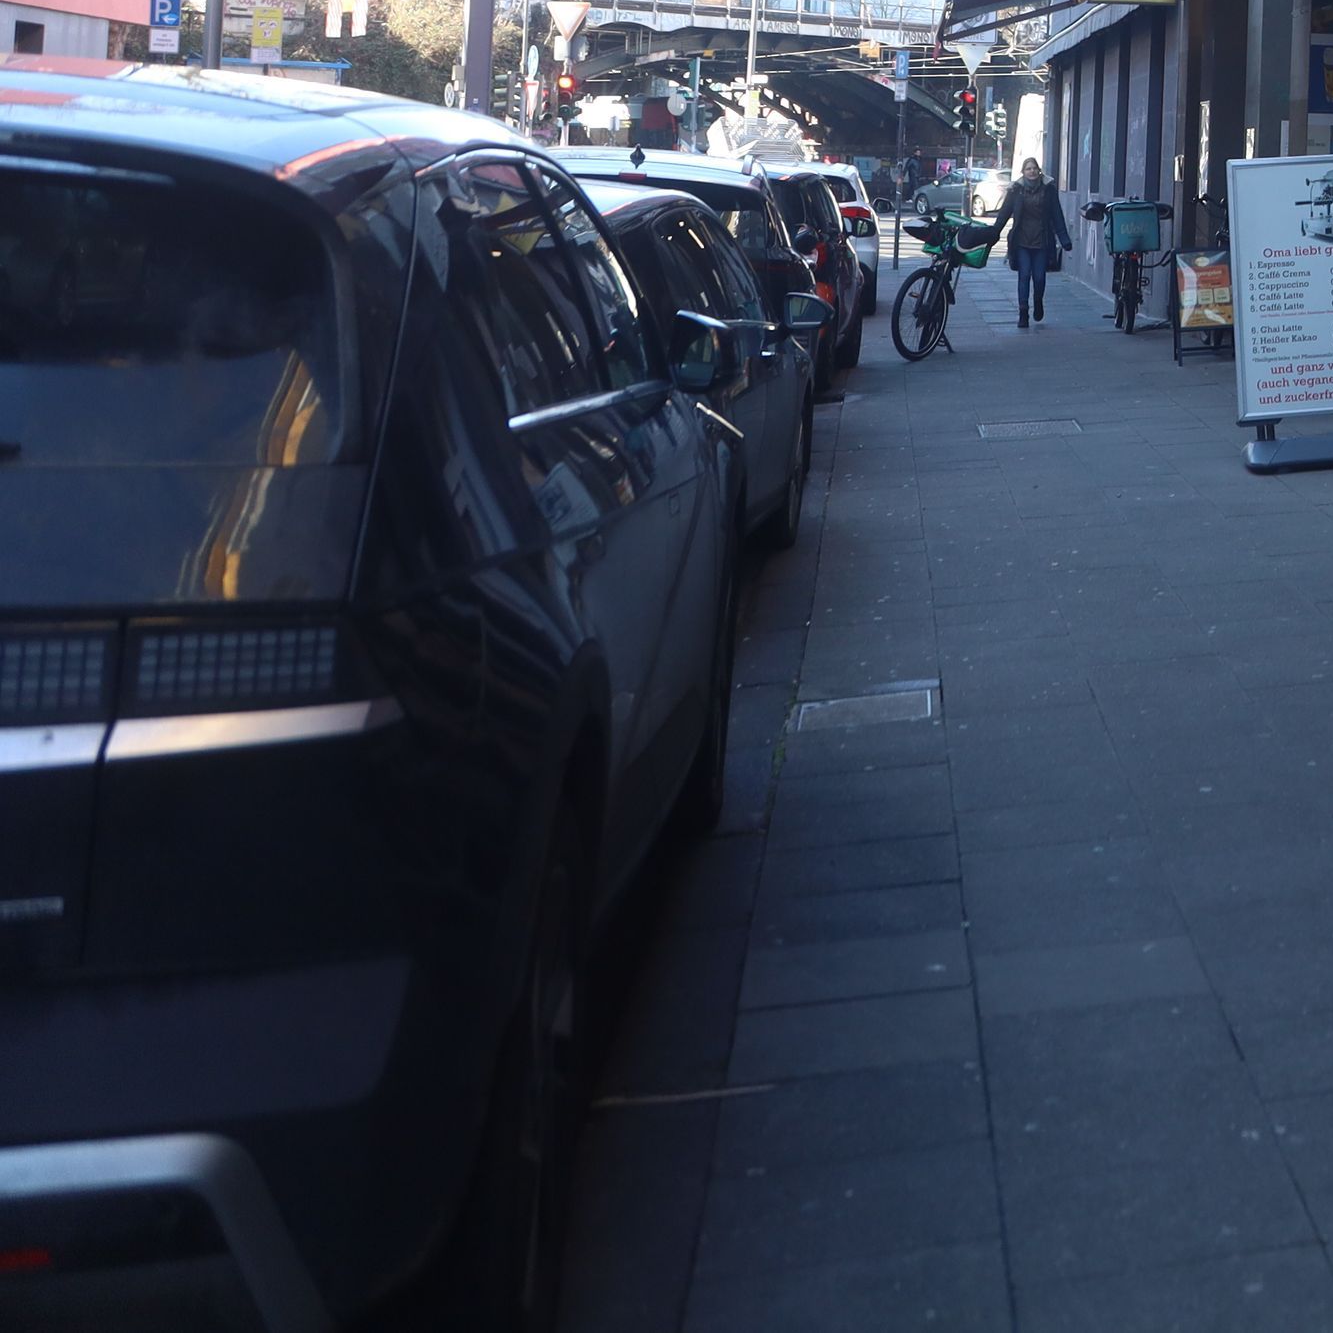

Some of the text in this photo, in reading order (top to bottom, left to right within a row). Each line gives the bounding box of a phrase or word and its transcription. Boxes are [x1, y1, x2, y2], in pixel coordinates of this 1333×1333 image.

[1263, 248, 1291, 258] Oma
[1295, 245, 1321, 257] liebt
[1257, 260, 1295, 270] Espresso
[1282, 270, 1311, 278] Crema
[1258, 281, 1309, 291] Cappuccino
[1283, 292, 1304, 300] Latte
[1260, 325, 1281, 334] Chai
[1282, 324, 1303, 332] Latte
[1260, 336, 1289, 345] Heißer
[1291, 333, 1318, 343] Kakao
[1260, 345, 1277, 354] Tee
[1271, 364, 1293, 375] und
[1296, 362, 1324, 375] ganz
[1256, 377, 1290, 391] (auch
[1259, 394, 1282, 405] und
